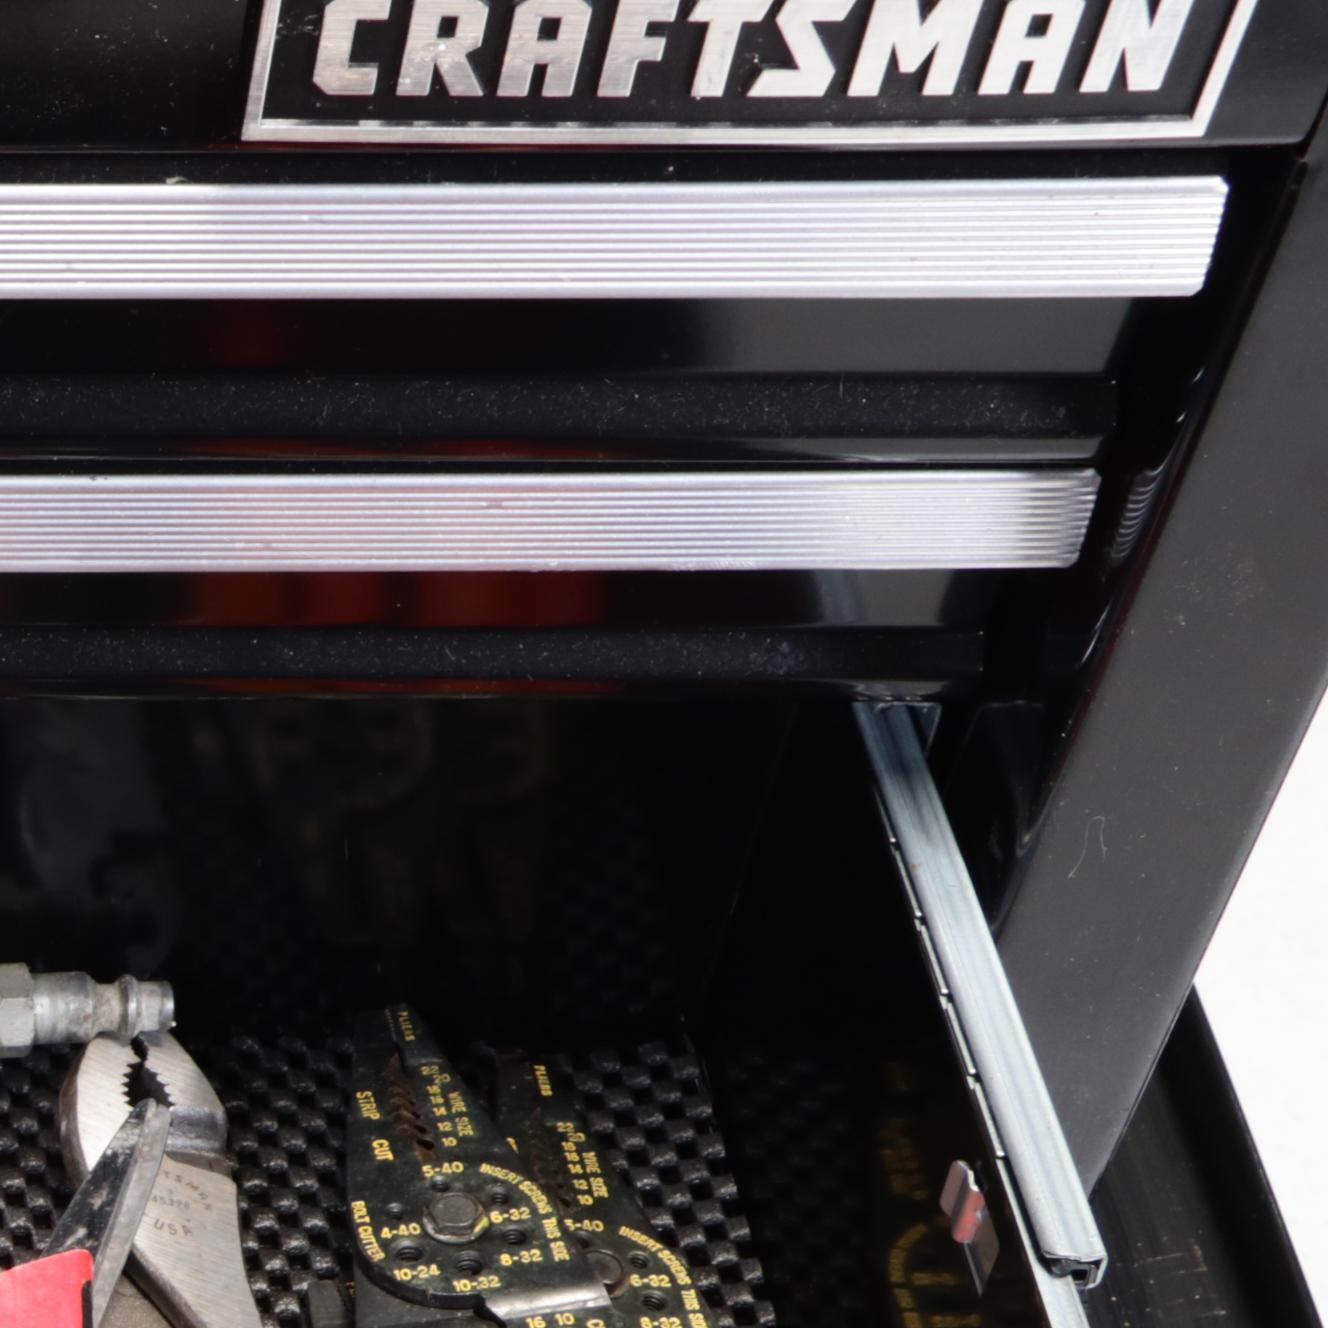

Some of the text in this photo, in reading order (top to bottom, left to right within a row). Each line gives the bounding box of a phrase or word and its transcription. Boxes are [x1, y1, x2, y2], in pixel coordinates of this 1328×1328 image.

[311, 0, 1192, 98] CRAFTSMAN
[448, 1091, 474, 1137] WIRE SIZE
[356, 1091, 394, 1161] STRIP CUT
[437, 1121, 453, 1131] 12
[442, 1136, 457, 1147] 10
[421, 1161, 464, 1178] 5-40
[479, 1163, 524, 1184] INSERT
[582, 1152, 609, 1198] WIRE SIZE
[490, 1207, 531, 1224] 6-32
[351, 1200, 385, 1262] BOLT CUTTER
[381, 1223, 421, 1240] 4-40
[542, 1216, 561, 1239] THIS
[499, 1249, 543, 1266] 8-32
[550, 1241, 570, 1262] SIDE
[393, 1264, 441, 1281] 10-24
[618, 1226, 664, 1252] INSERT
[681, 1289, 700, 1310] THIS
[453, 1275, 502, 1292] 10-32
[629, 1274, 672, 1288] 6-32
[554, 1312, 575, 1326] 10
